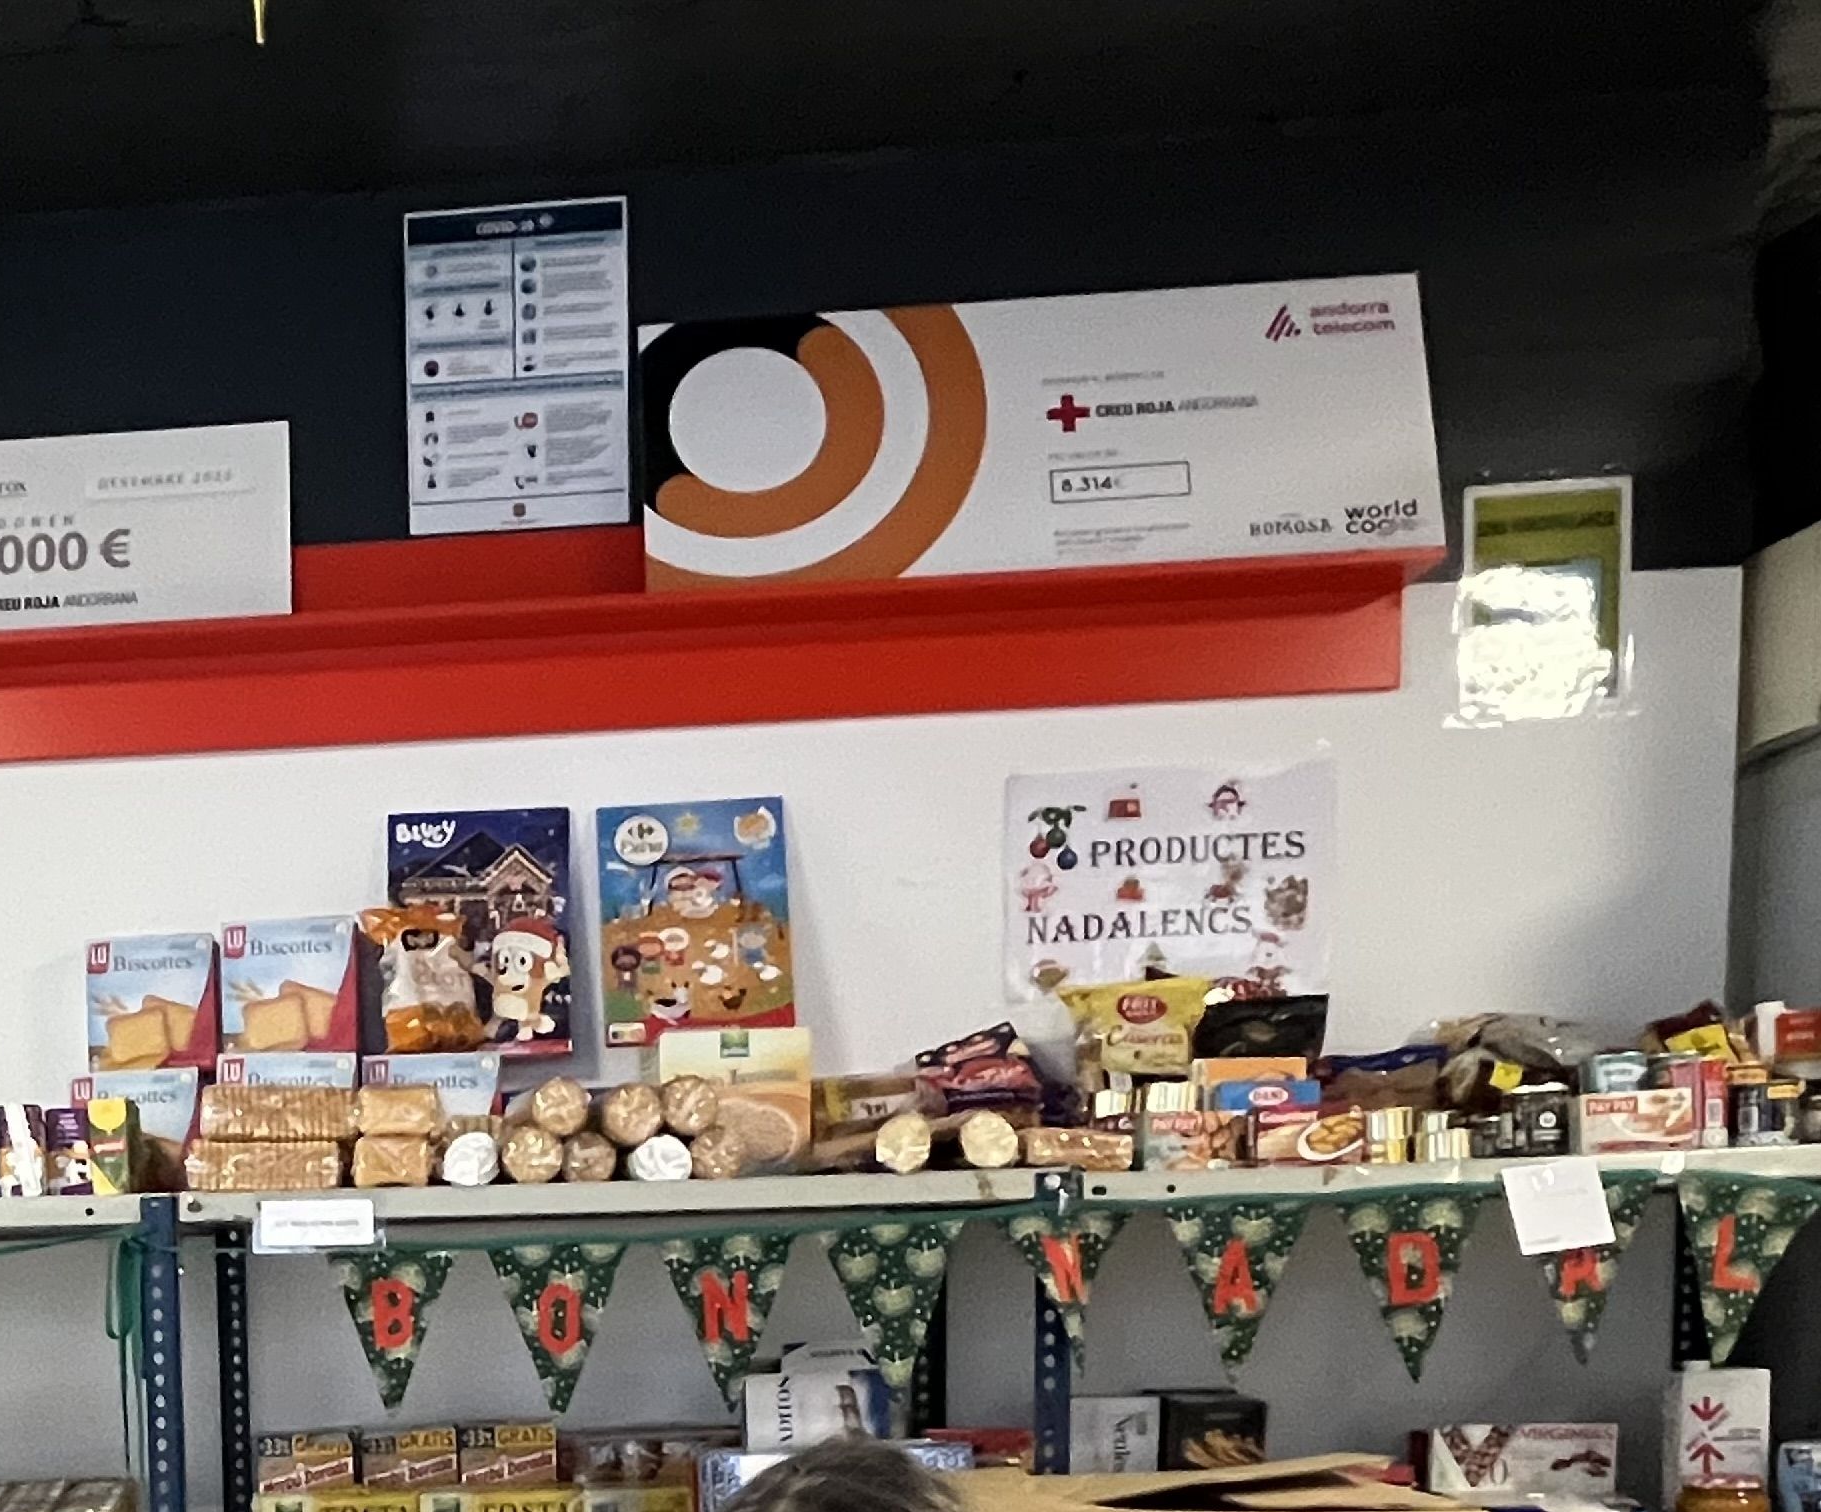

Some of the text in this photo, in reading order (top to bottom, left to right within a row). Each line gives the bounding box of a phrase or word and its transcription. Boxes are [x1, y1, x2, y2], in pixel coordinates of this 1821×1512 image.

[1345, 499, 1418, 521] world
[99, 528, 131, 569] €
[1089, 830, 1307, 867] PRODUCTES
[1027, 905, 1253, 945] NADALENCS
[90, 945, 108, 966] LU
[249, 937, 332, 957] Biscottes
[113, 954, 194, 973] Biscottes
